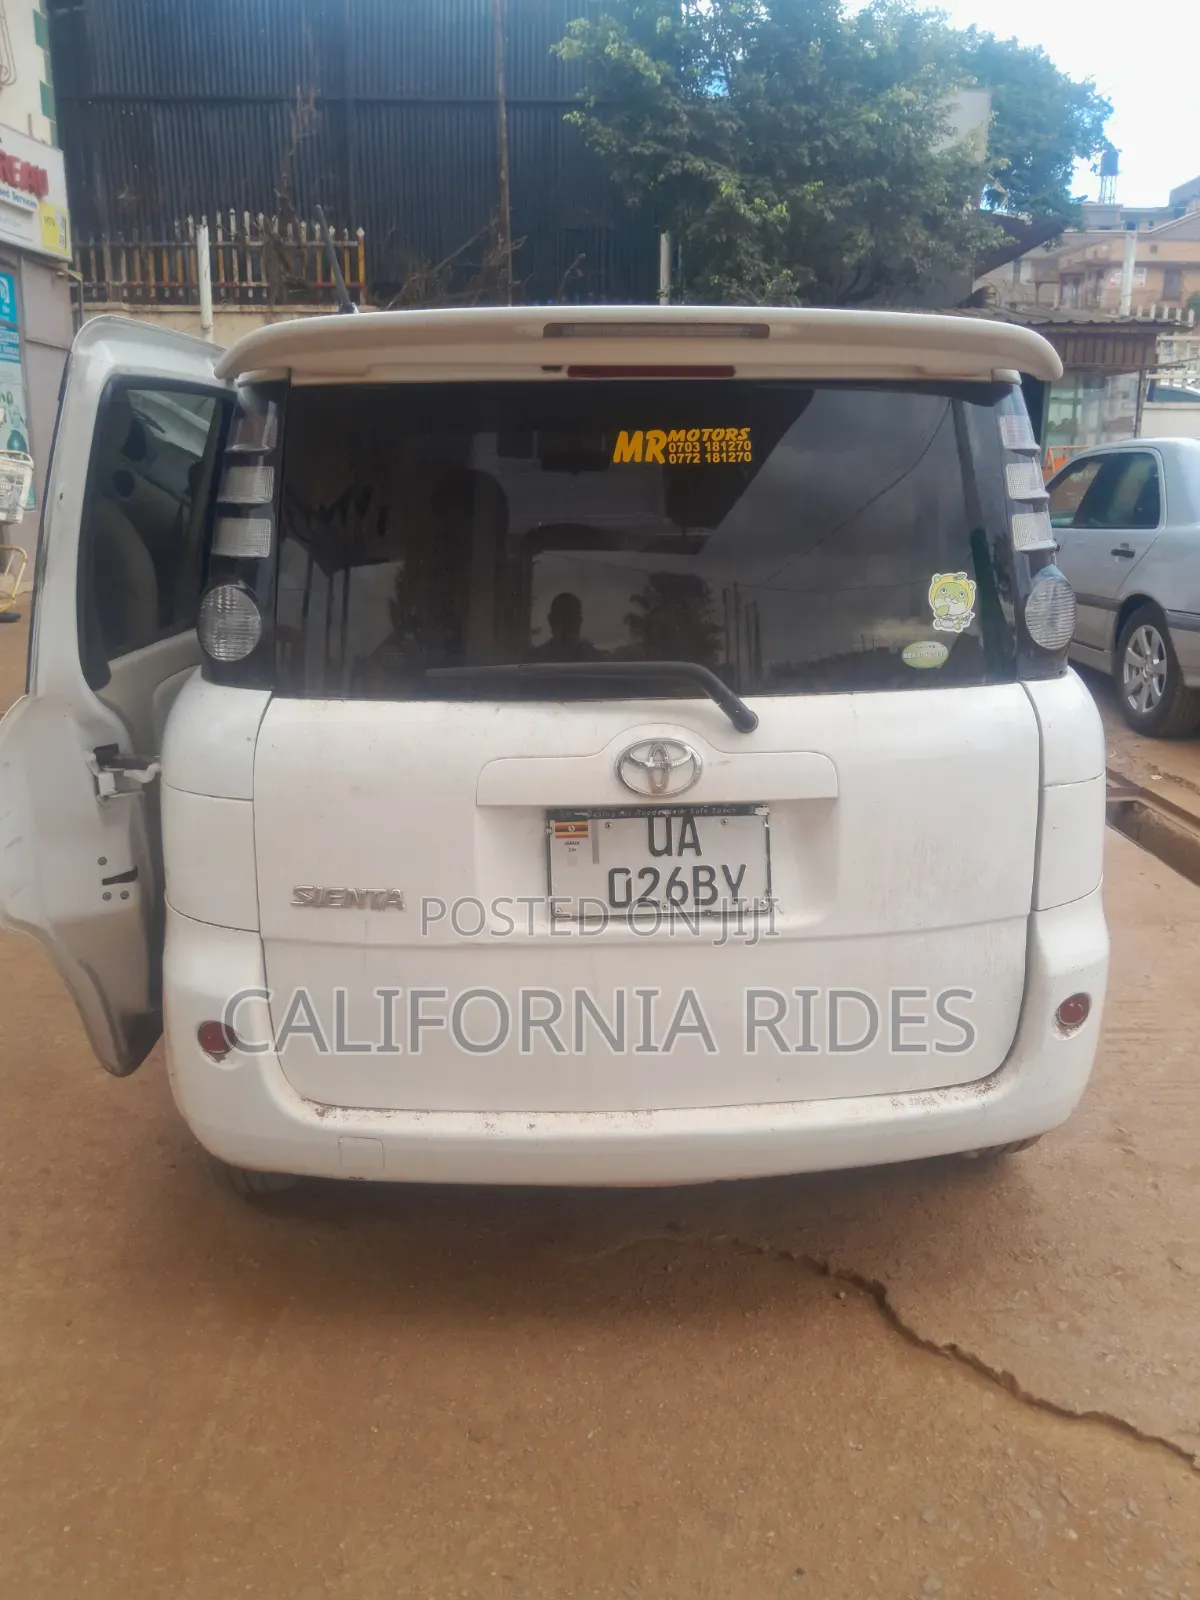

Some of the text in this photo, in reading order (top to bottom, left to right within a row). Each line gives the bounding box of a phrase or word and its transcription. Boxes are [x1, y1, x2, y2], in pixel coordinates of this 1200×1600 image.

[613, 428, 751, 464] MR MOTORS
[668, 440, 752, 453] 0703 181270
[669, 451, 752, 464] 0772 181270
[647, 814, 702, 857] UA
[290, 884, 405, 911] SIENTA
[608, 864, 747, 909] 026BY
